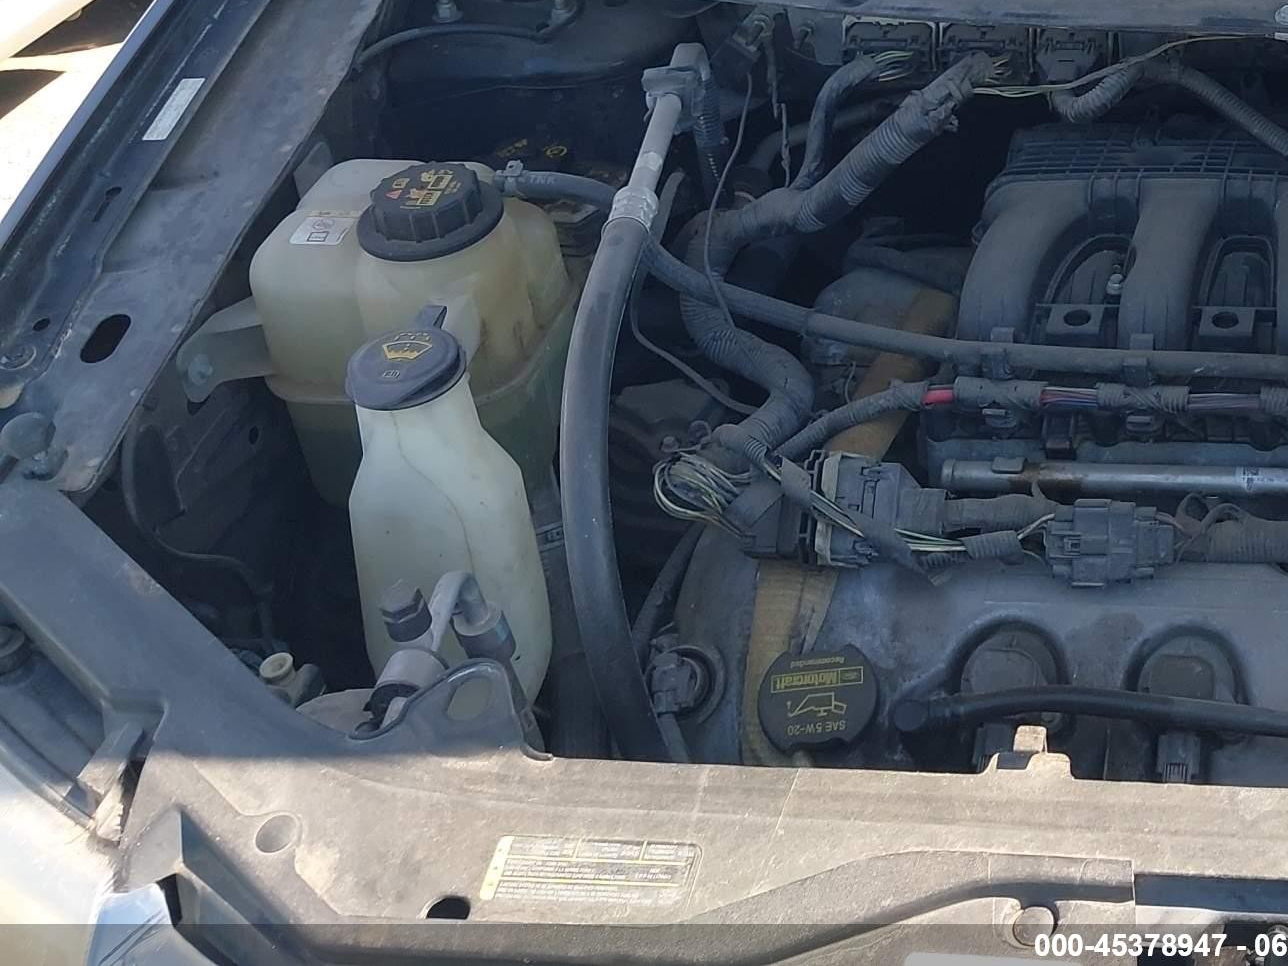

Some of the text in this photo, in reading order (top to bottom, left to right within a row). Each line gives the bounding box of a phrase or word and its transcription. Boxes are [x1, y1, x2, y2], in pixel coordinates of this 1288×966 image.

[775, 670, 838, 690] Motorcraft
[787, 720, 847, 736] SAE 5W-20
